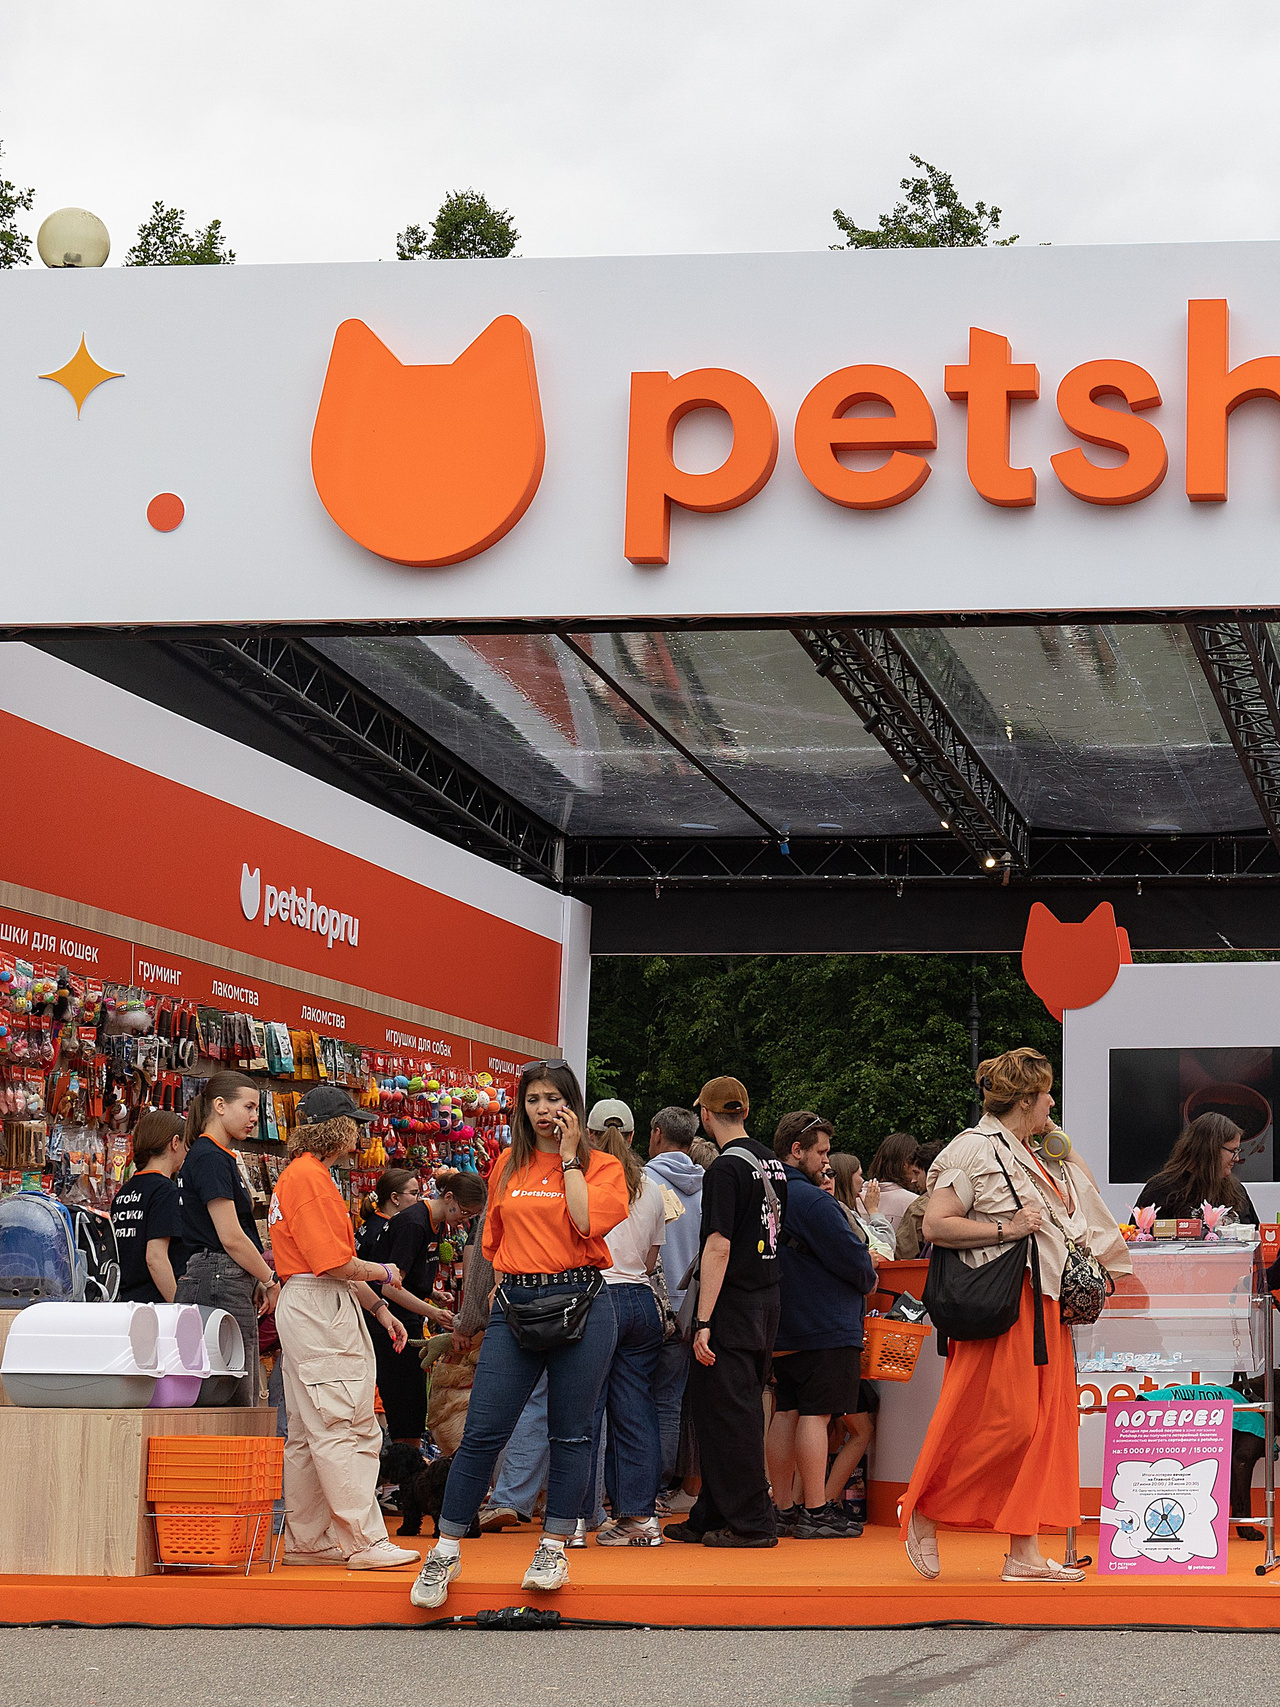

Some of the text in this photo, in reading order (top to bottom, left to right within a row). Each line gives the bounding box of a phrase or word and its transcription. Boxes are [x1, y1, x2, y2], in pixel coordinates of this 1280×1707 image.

[263, 884, 360, 949] petshopru
[0, 923, 100, 964] шки для кошек
[138, 960, 183, 986] груминг
[211, 979, 260, 1007] лакомства
[300, 1004, 346, 1029] лакомства
[385, 1028, 452, 1058] игрушки для собак
[488, 1056, 515, 1075] игрушки
[1171, 1389, 1196, 1400] ИЩУ
[1114, 1409, 1225, 1428] ЛОТЕРЕЯ
